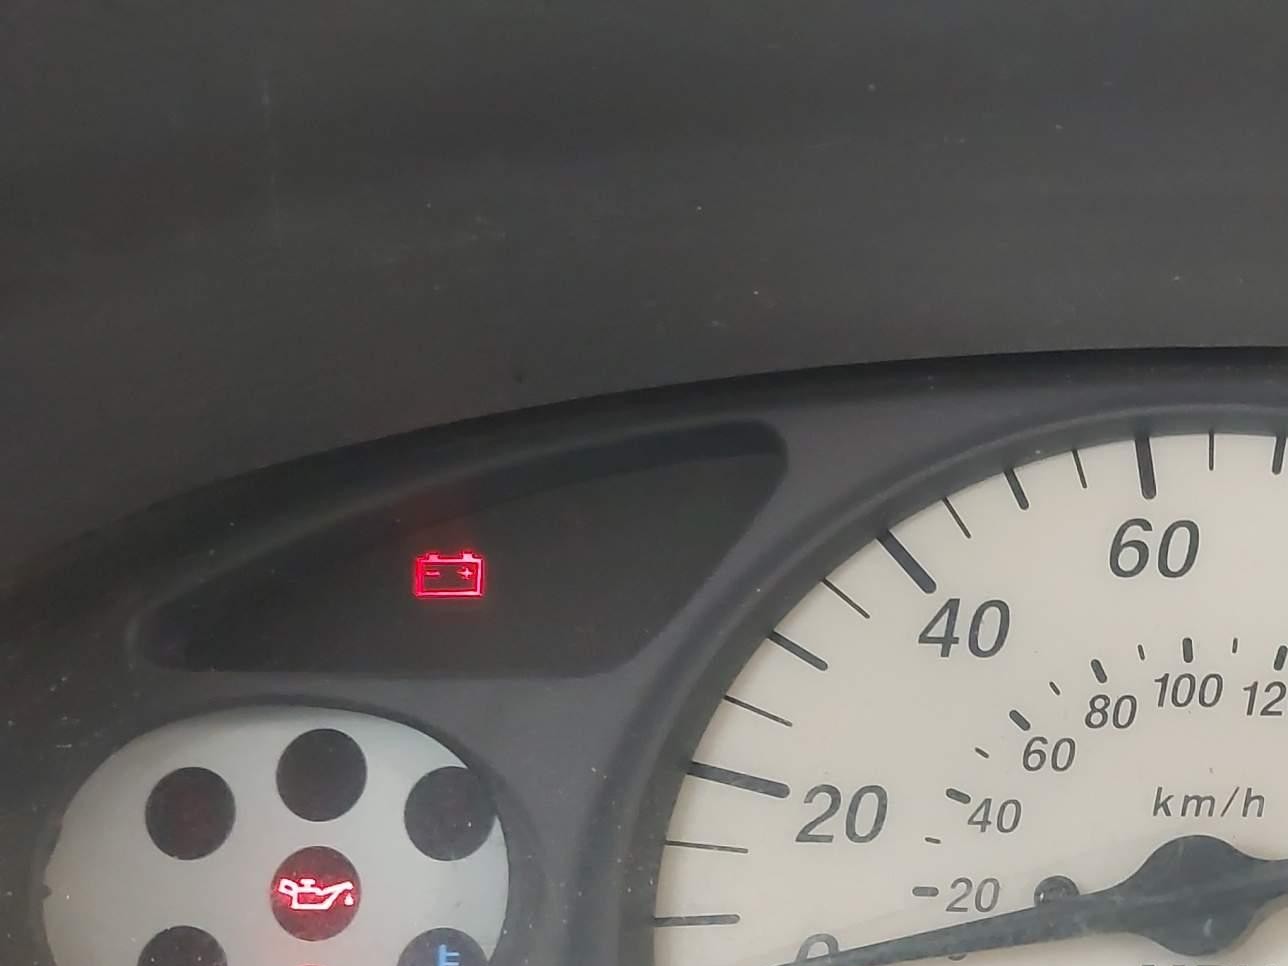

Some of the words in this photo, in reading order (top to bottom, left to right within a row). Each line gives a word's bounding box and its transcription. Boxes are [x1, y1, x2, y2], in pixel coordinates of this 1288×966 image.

[1109, 518, 1200, 578] 60
[918, 598, 1011, 658] 40
[1154, 673, 1224, 708] 100
[1084, 694, 1137, 729] 80
[1022, 737, 1076, 772] 60
[795, 785, 888, 844] 20
[967, 798, 1022, 833] 40
[1152, 786, 1265, 818] km/h
[945, 877, 1000, 912] 20
